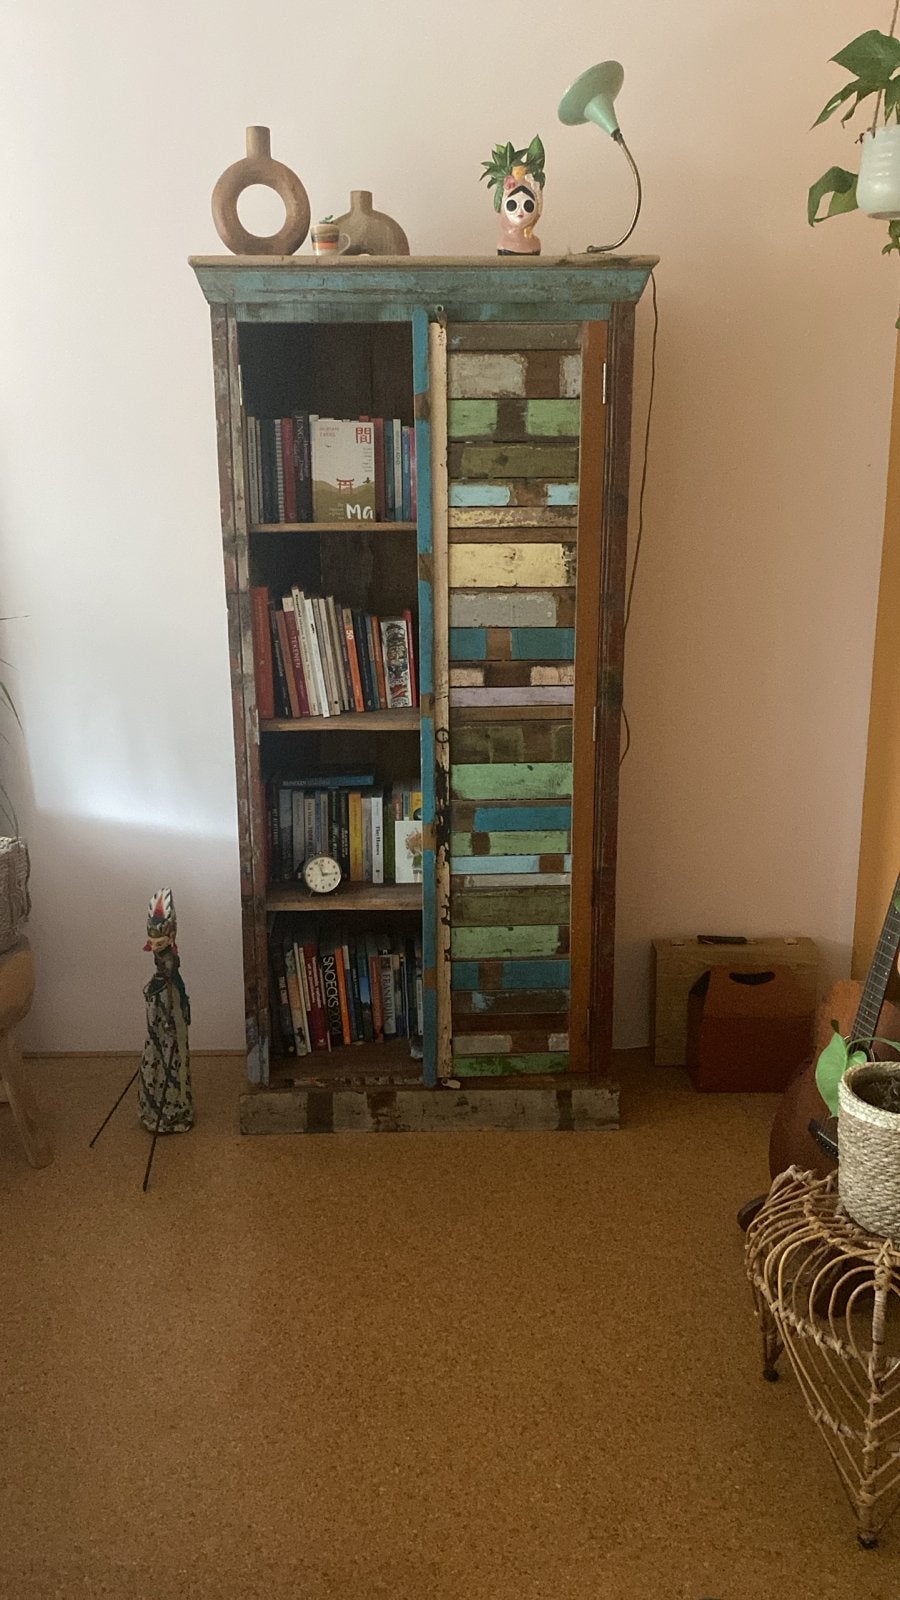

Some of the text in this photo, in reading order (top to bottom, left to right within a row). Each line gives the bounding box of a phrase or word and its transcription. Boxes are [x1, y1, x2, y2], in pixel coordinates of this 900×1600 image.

[355, 427, 371, 444] 間
[346, 503, 374, 520] Ma
[346, 629, 354, 640] 50
[323, 956, 339, 1008] SNOECKS
[328, 1008, 341, 1035] 2004
